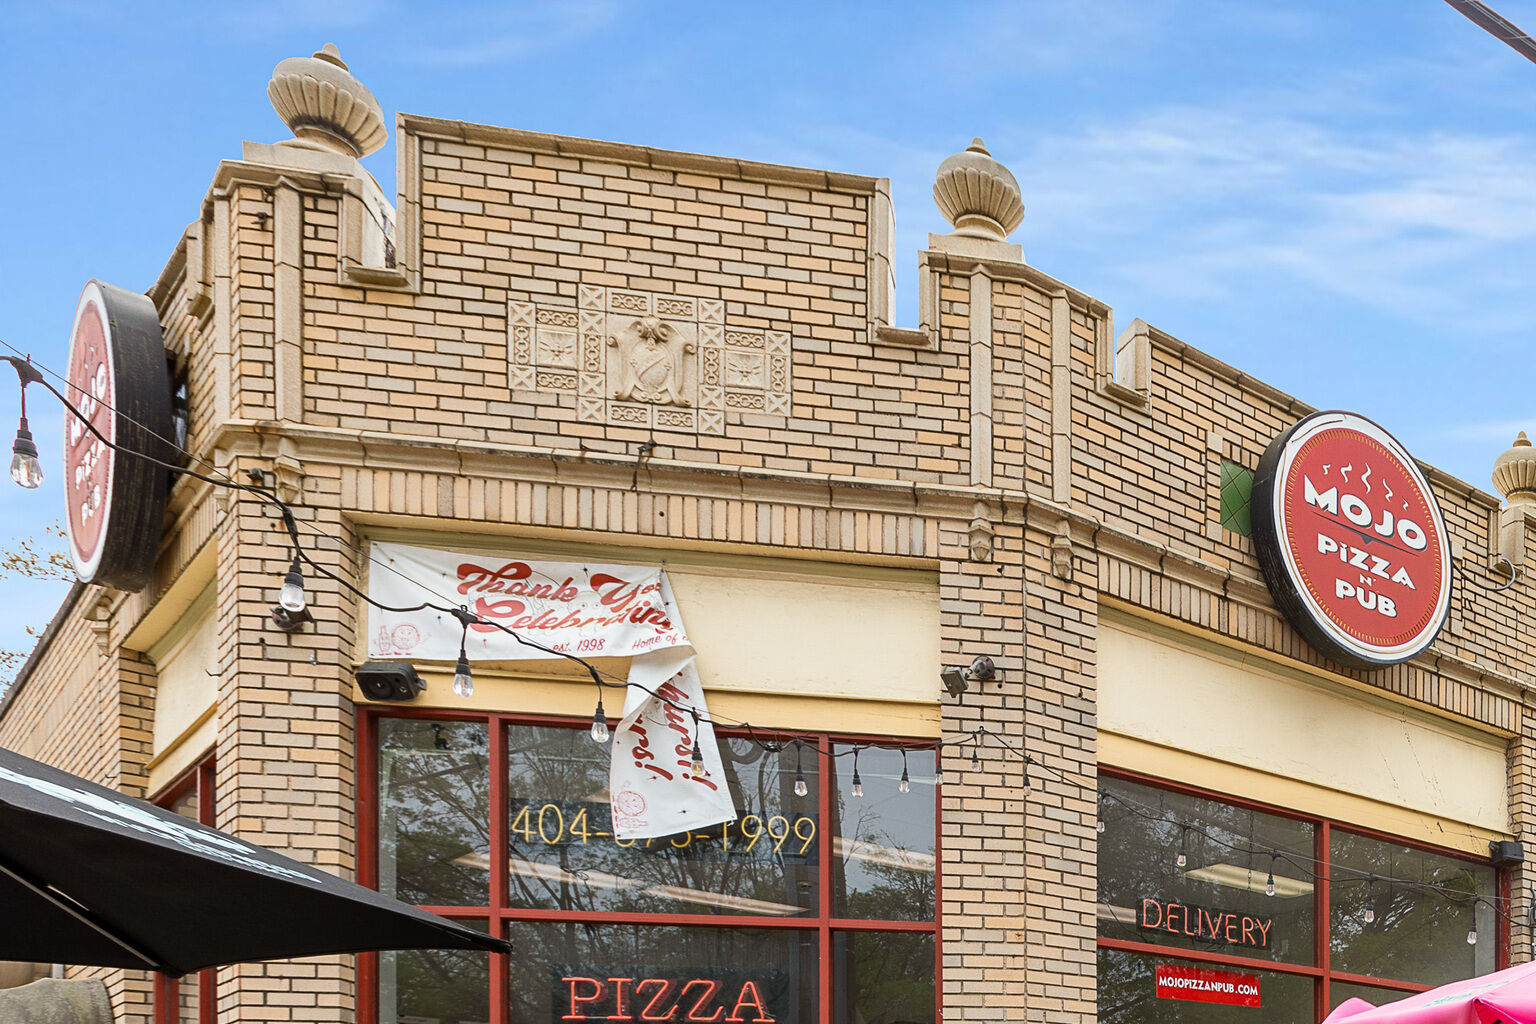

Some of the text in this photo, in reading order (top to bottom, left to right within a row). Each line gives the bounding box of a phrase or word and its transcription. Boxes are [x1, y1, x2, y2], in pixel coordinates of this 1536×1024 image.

[70, 361, 107, 447] MOJO
[1304, 474, 1428, 552] MOJO
[457, 562, 579, 601] Thank
[1335, 578, 1398, 618] PUB
[577, 638, 606, 652] 1998
[632, 634, 661, 650] Home
[665, 632, 678, 645] of
[511, 803, 817, 855] 404--1999
[1142, 898, 1272, 947] DELIVERY
[561, 976, 776, 1024] PIZZA
